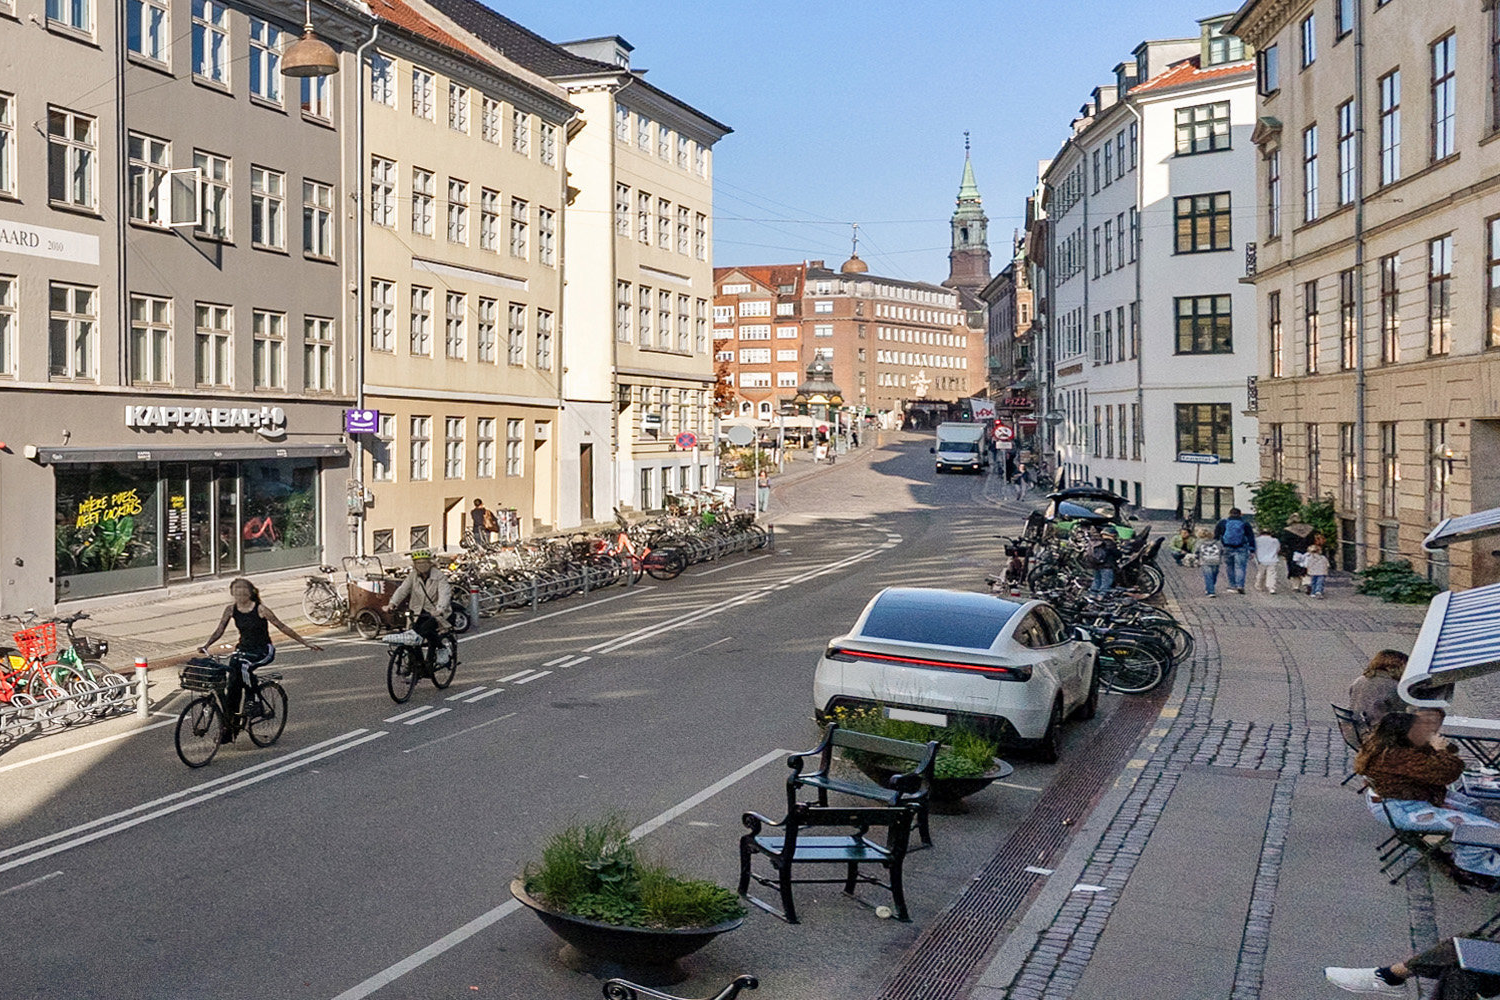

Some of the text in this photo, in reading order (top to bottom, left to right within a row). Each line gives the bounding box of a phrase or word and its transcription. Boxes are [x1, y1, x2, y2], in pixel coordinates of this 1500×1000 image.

[125, 405, 260, 427] KAPPA BAR
[78, 495, 109, 515] WHERE
[76, 510, 102, 530] MEET
